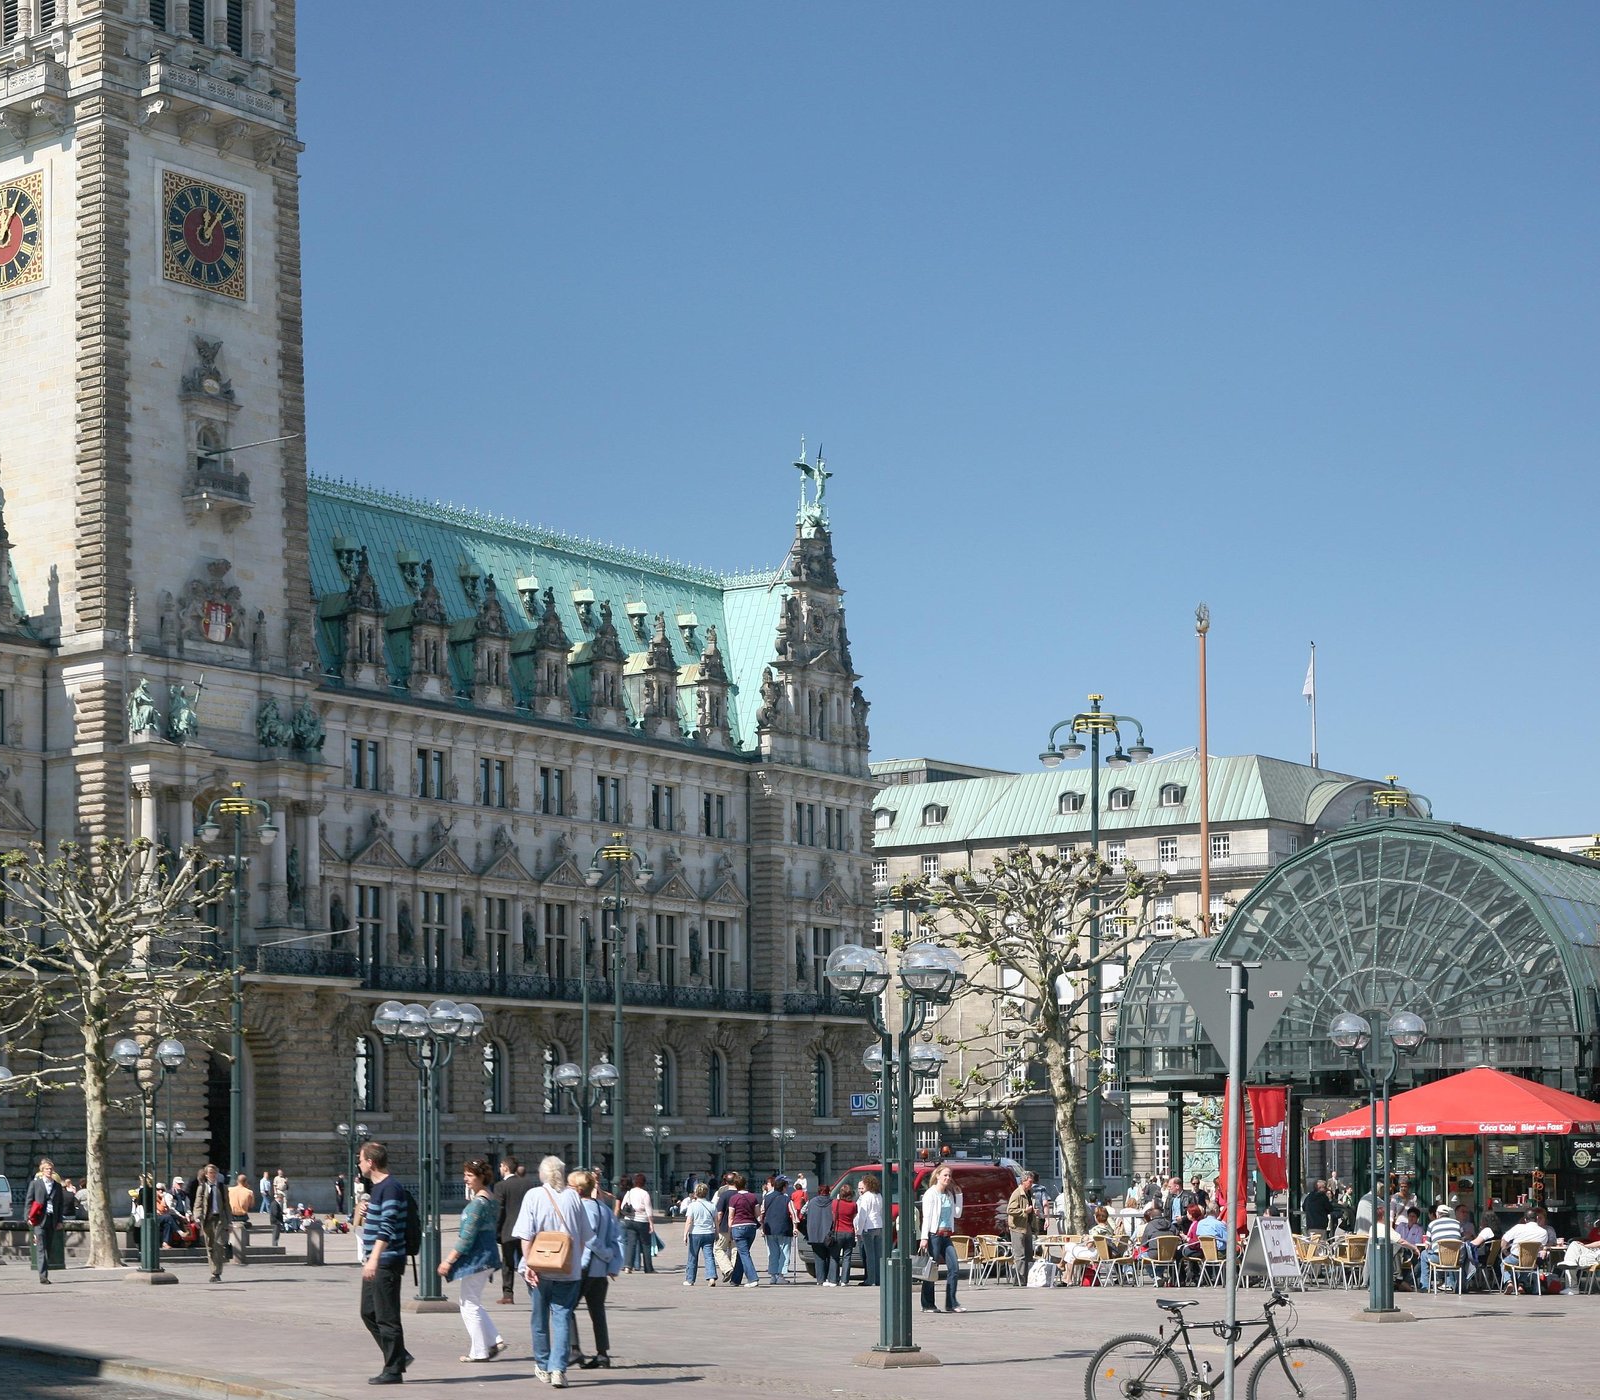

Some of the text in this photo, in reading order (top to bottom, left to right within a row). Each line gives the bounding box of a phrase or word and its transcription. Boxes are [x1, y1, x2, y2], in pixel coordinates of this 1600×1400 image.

[852, 1095, 876, 1108] U S
[1376, 1126, 1407, 1136] Crques
[1416, 1124, 1437, 1133] Pizza
[1479, 1123, 1498, 1132] Coca
[1499, 1123, 1516, 1132] Cola
[1521, 1123, 1535, 1131] Bier
[1547, 1123, 1564, 1131] Fass
[1272, 1236, 1280, 1246] to
